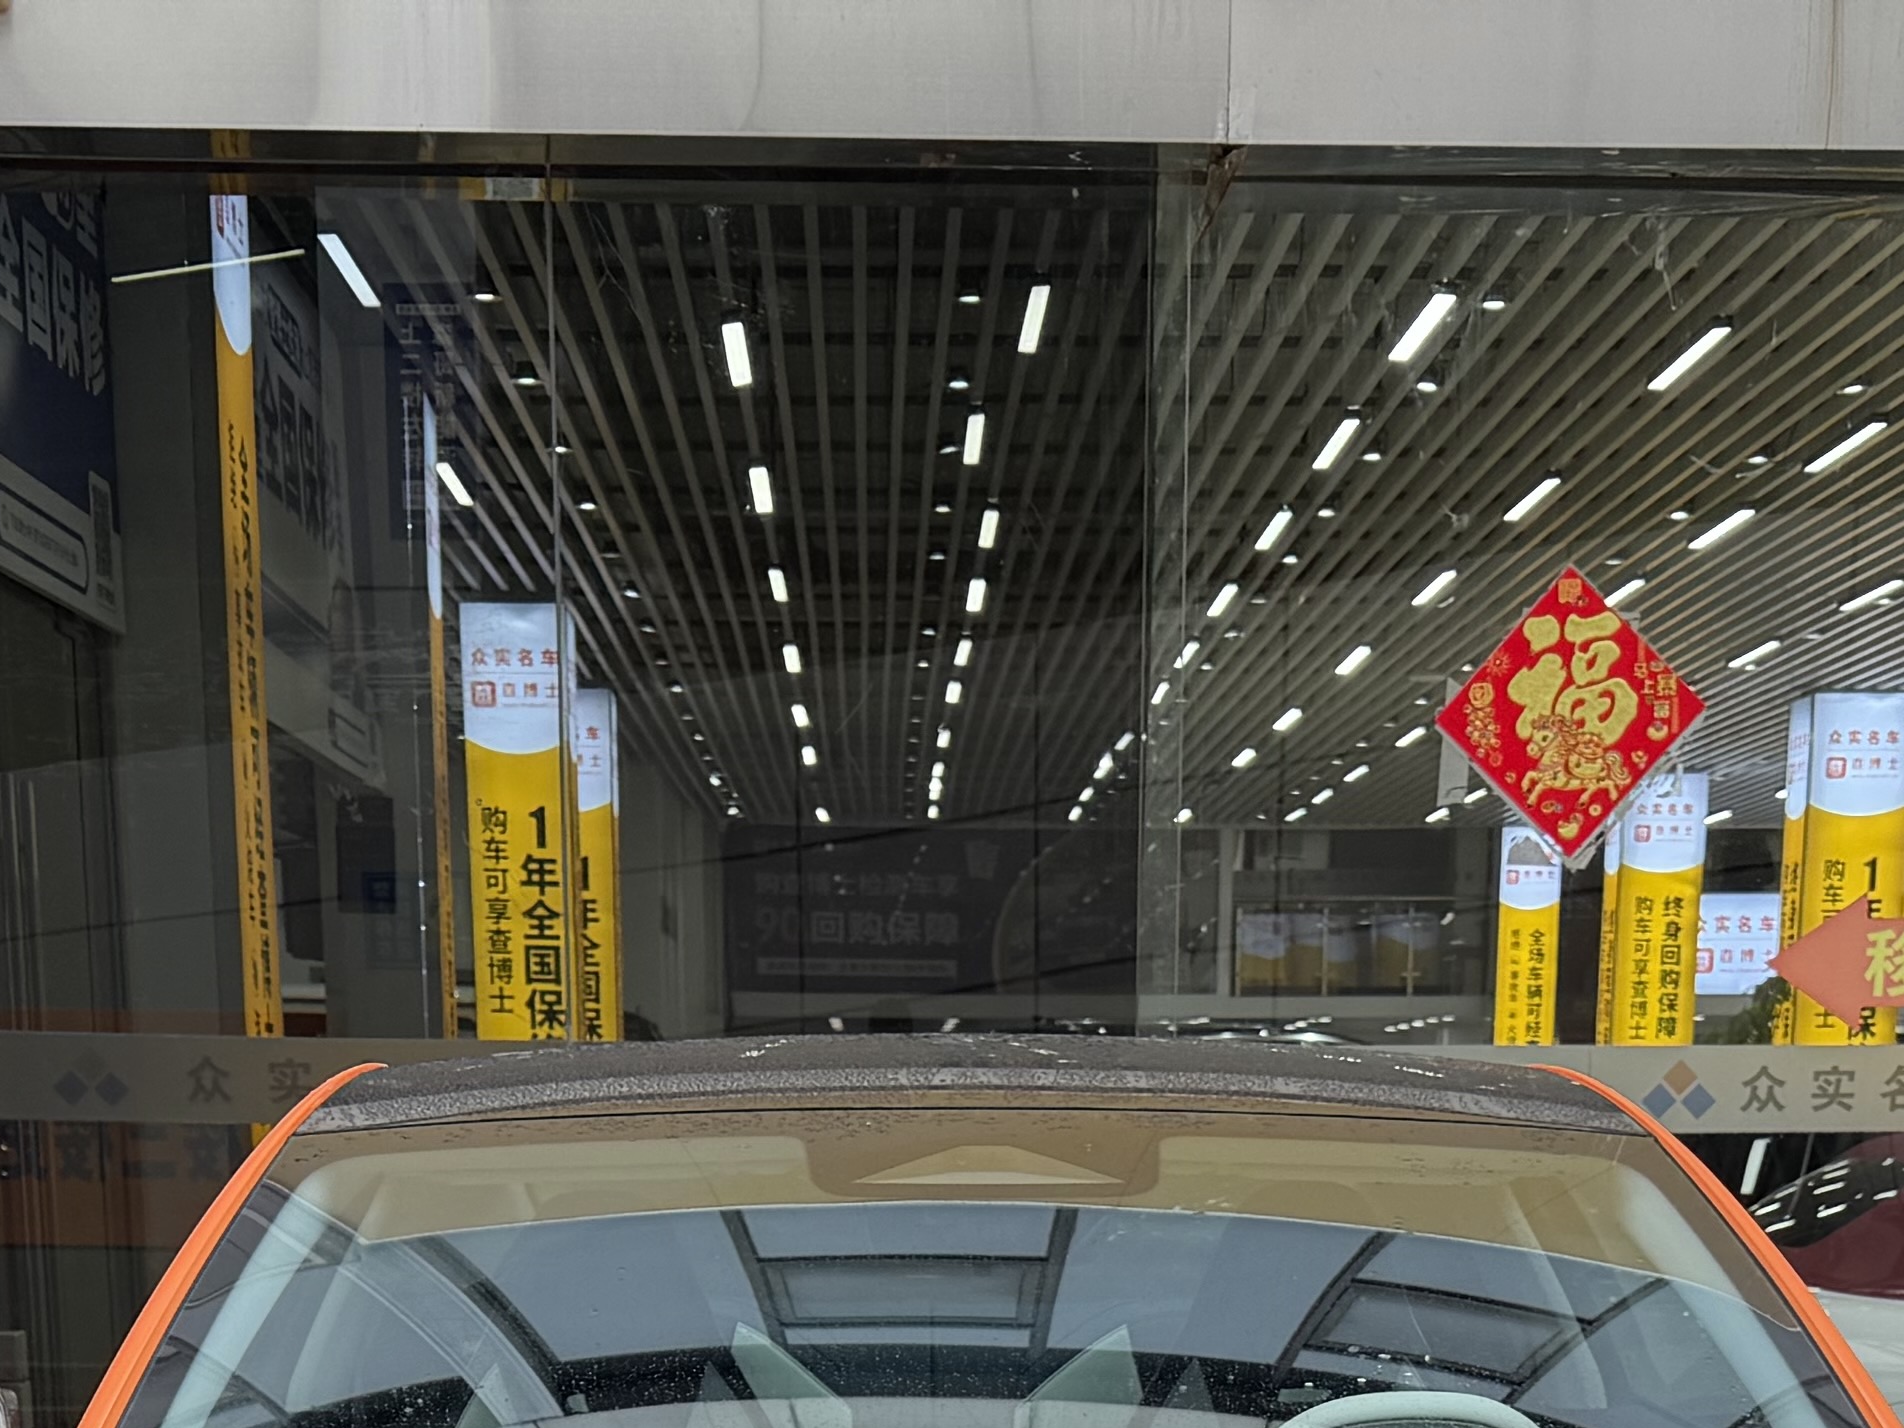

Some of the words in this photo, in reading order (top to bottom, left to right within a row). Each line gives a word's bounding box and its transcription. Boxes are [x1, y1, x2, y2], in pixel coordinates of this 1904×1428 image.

[471, 648, 560, 667] 众实名车
[1507, 611, 1639, 746] 福
[1828, 729, 1901, 746] 众实名车
[481, 806, 515, 1015] 购车可享查博士
[520, 805, 567, 1041] 1年全国保
[1525, 928, 1546, 1044] 全场车辆可经
